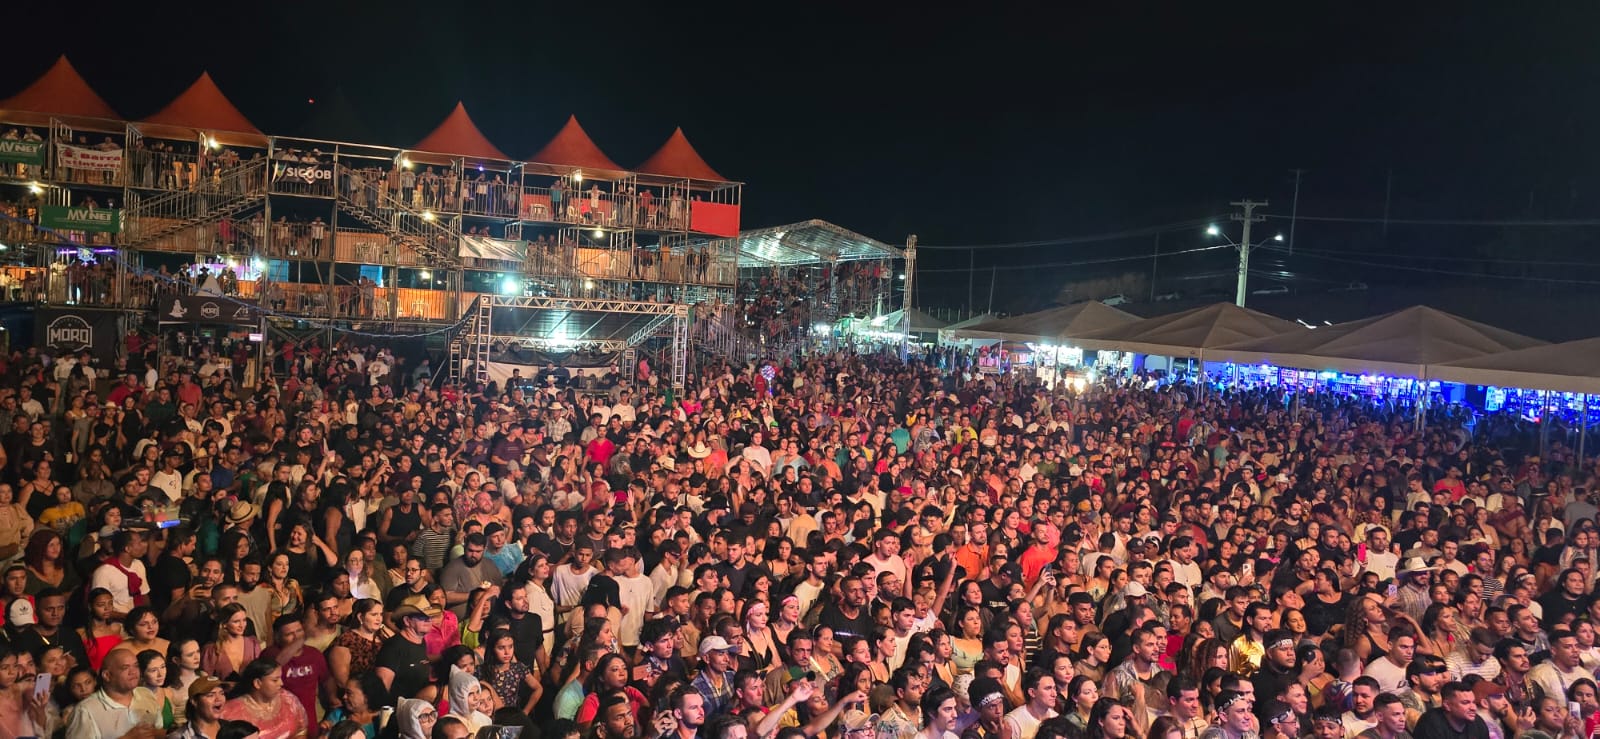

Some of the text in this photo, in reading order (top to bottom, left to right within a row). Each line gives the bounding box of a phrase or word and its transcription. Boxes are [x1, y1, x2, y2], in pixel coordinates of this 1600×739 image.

[80, 153, 121, 161] Barra
[286, 166, 332, 180] SICOOB
[51, 328, 89, 343] MORO
